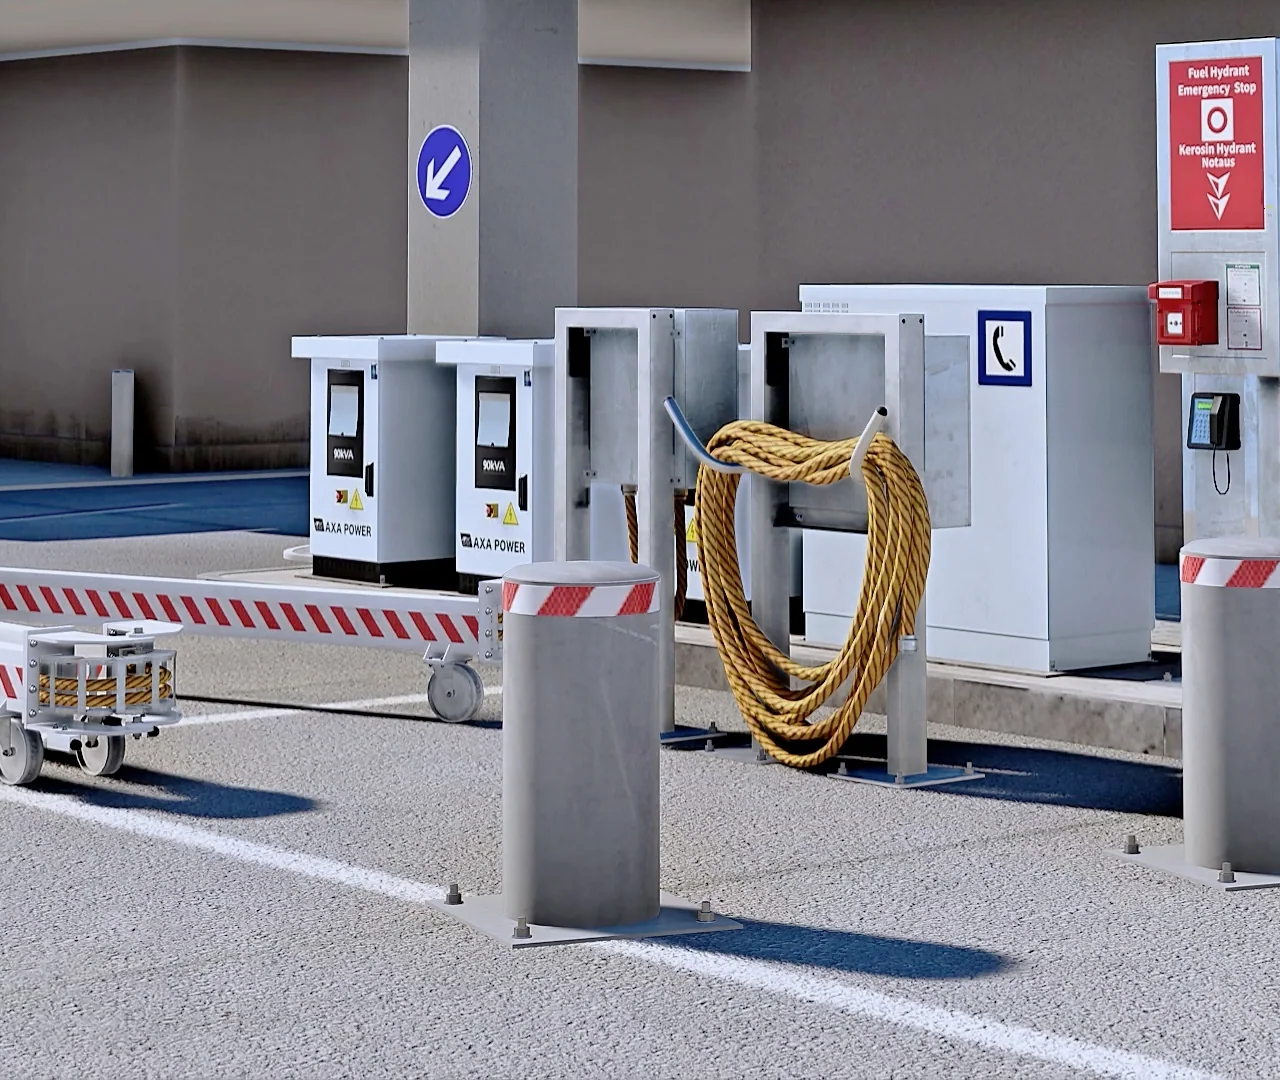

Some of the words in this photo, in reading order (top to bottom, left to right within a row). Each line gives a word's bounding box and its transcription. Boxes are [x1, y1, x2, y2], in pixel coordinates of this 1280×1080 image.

[1188, 65, 1209, 79] Fuel
[1210, 64, 1250, 80] Hydrant
[1178, 84, 1230, 98] Emergency
[1234, 81, 1257, 95] Stop
[1179, 142, 1215, 156] Kerosin
[1216, 142, 1257, 157] Hydrant
[1202, 156, 1236, 168] Notaus
[325, 521, 342, 534] AXA
[344, 523, 372, 537] POWER
[473, 536, 493, 550] AXA
[494, 539, 526, 554] POWER
